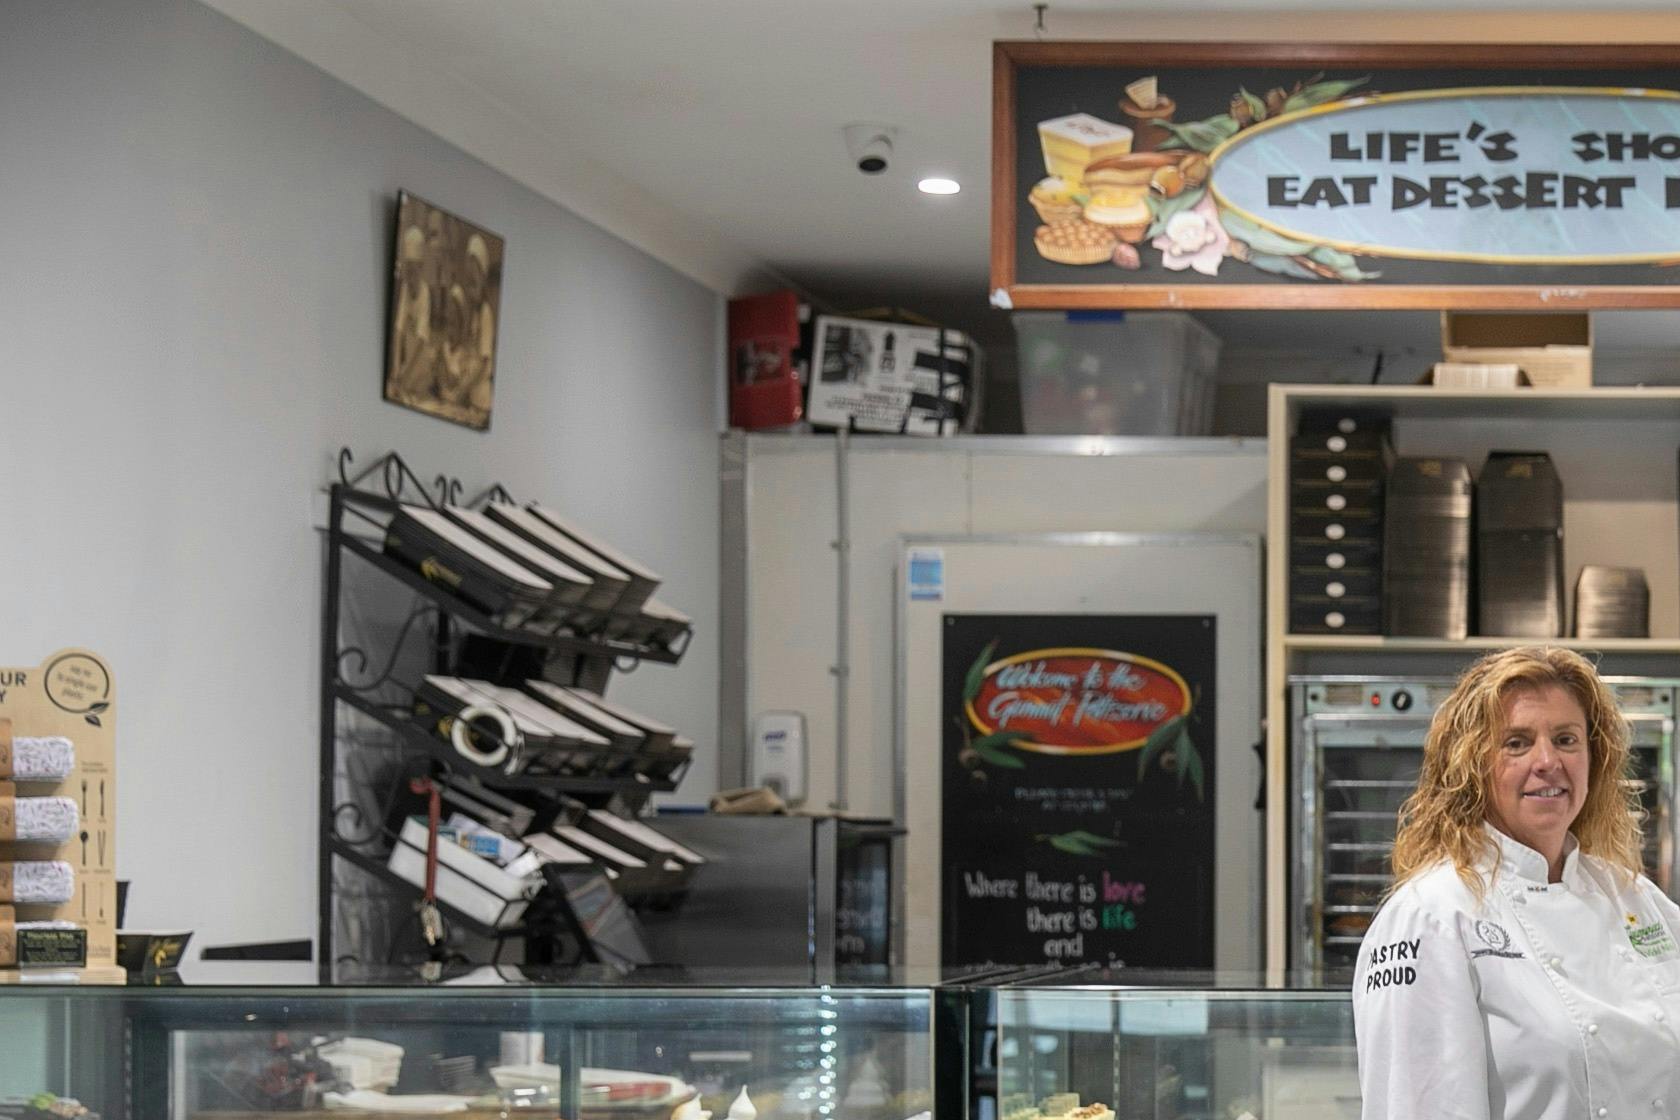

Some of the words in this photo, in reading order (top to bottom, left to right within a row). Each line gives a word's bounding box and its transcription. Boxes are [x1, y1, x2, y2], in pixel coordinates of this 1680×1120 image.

[1330, 121, 1519, 162] LIFE'S
[1267, 175, 1378, 208] EAT
[1391, 173, 1635, 211] DESSERT
[996, 660, 1077, 690] Welcome
[1082, 661, 1103, 690] to
[1107, 662, 1146, 692] the
[964, 869, 1019, 899] Where
[1025, 870, 1075, 903] there
[1078, 873, 1097, 903] is
[1102, 869, 1146, 904] love
[1026, 906, 1076, 933] there
[1078, 905, 1098, 931] is
[1102, 903, 1137, 931] life
[1043, 931, 1084, 958] and
[1366, 966, 1417, 994] PROUD
